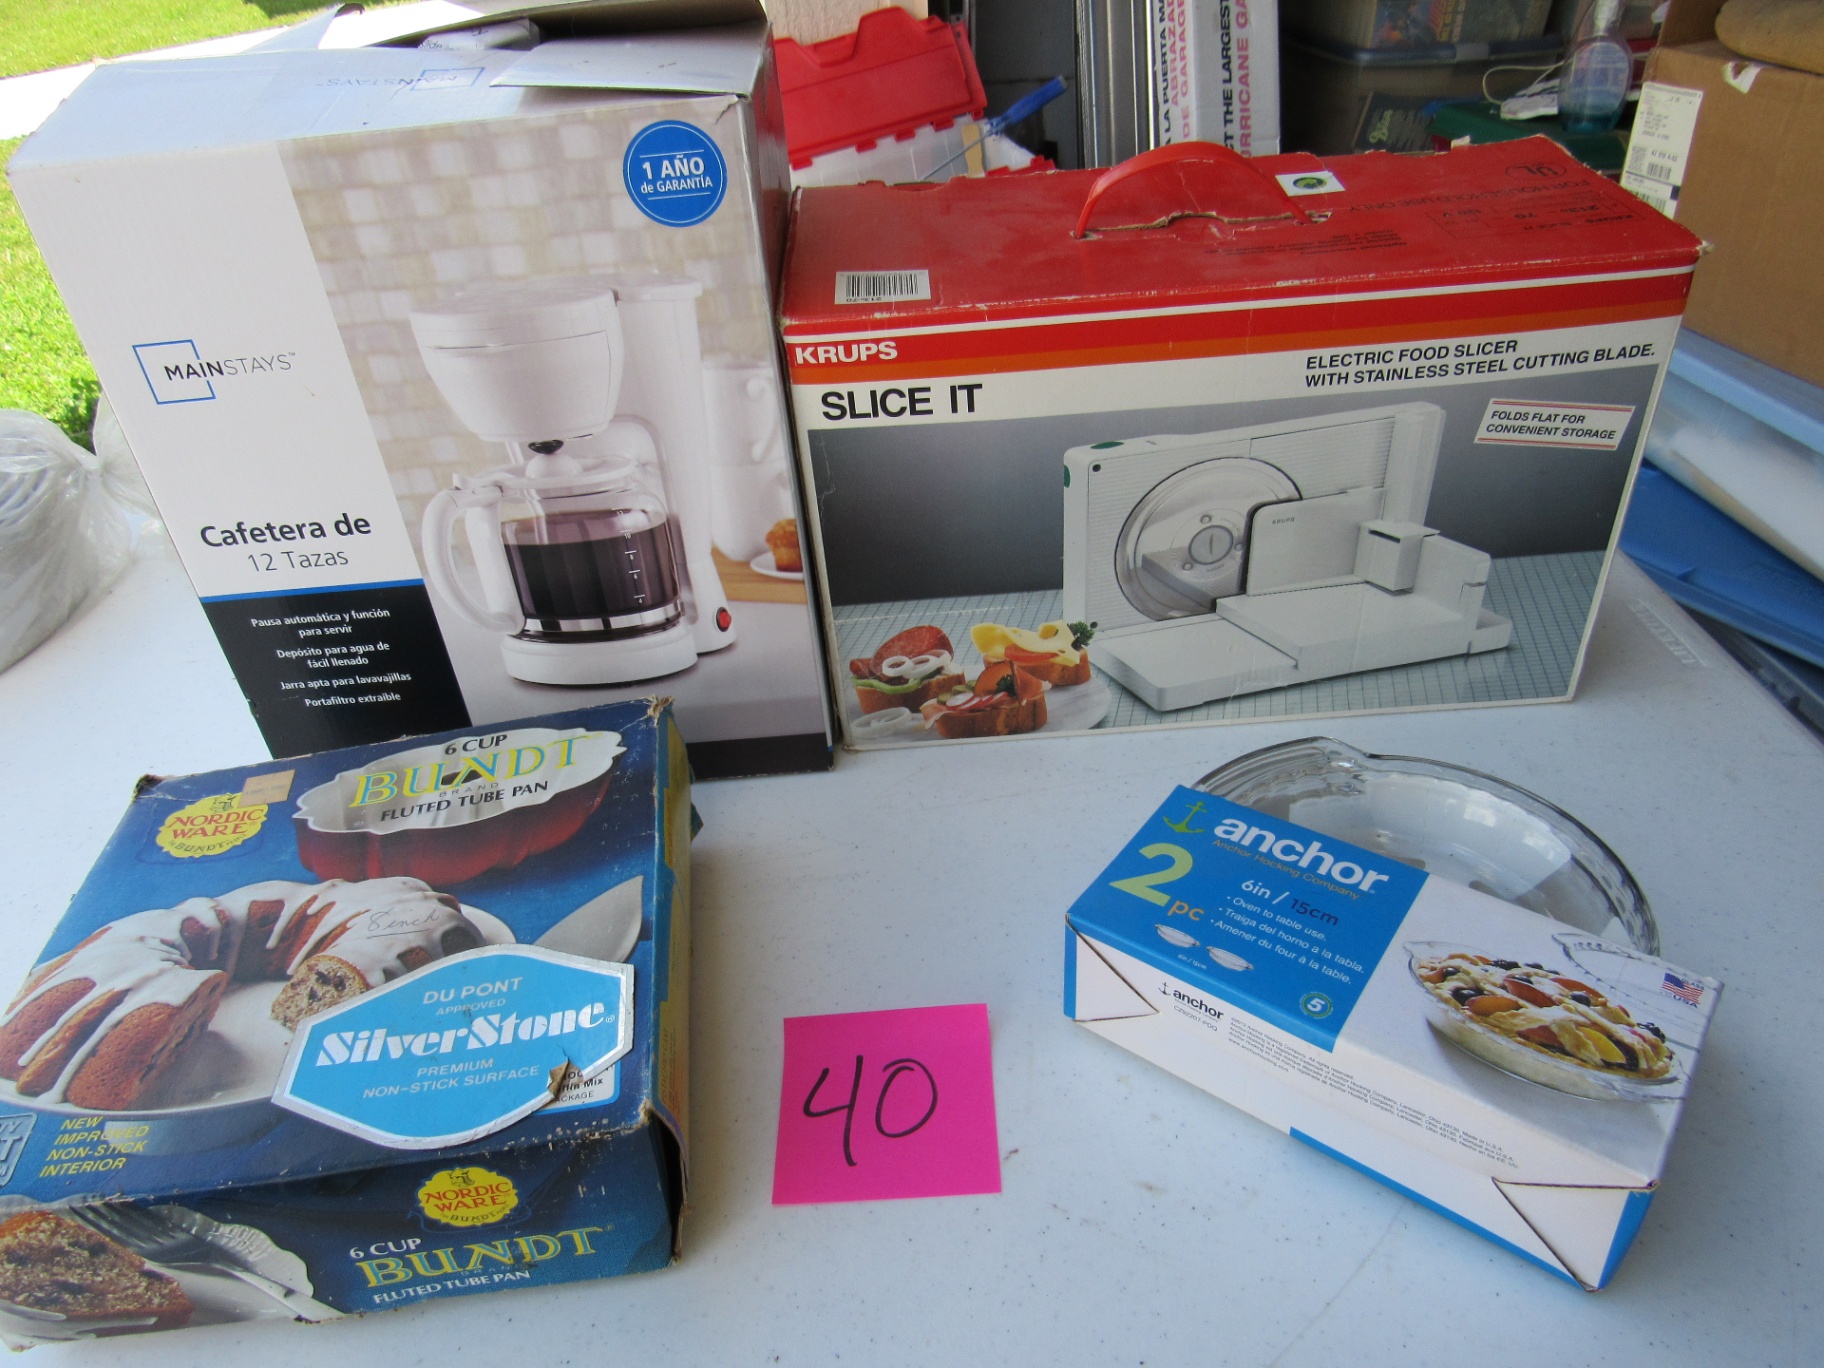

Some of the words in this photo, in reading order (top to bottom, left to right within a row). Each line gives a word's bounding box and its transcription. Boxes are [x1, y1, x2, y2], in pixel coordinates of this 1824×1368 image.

[1159, 28, 1170, 104] PUERTA
[1223, 89, 1233, 128] THE
[1163, 109, 1171, 133] LA
[1181, 105, 1190, 139] DE
[642, 161, 653, 180] 1
[660, 154, 705, 179] AÑO
[640, 181, 654, 194] de
[656, 174, 713, 193] GARANTÍA
[795, 341, 898, 365] KRUPS
[1305, 350, 1395, 370] ELECTRIC
[1398, 345, 1450, 363] FOOD
[1453, 339, 1518, 358] SLICER
[1305, 371, 1349, 388] WITH
[1353, 364, 1449, 385] STAINLESS
[1453, 359, 1508, 377] STEEL
[1512, 350, 1589, 371] CUTTING
[1593, 343, 1655, 363] BLADE.
[820, 386, 934, 421] SLICE
[949, 383, 983, 414] IT
[1490, 410, 1531, 422] FOLDS
[1531, 412, 1560, 423] FLAT
[1562, 414, 1586, 425] FOR
[1486, 423, 1560, 437] CONVENIENT
[1561, 427, 1617, 441] STORAGE
[200, 519, 327, 548] Cafetera
[333, 512, 372, 537] de
[247, 553, 278, 572] 12
[280, 550, 349, 569] Tazas
[250, 617, 282, 628] Pausa
[284, 611, 342, 625] automática
[343, 613, 350, 623] y
[351, 608, 391, 620] función
[298, 628, 322, 639] para
[323, 624, 353, 635] servir
[276, 647, 323, 659] Depósito
[324, 646, 348, 657] para
[349, 643, 375, 655] agua
[377, 641, 390, 651] de
[307, 658, 331, 669] fácil
[331, 655, 369, 667] llenado
[281, 679, 306, 690] Jarra
[307, 678, 331, 690] apta
[332, 676, 355, 688] para
[356, 671, 412, 686] lavavajillas
[305, 695, 356, 707] Portafiltro
[357, 691, 402, 704] extraíble
[444, 741, 457, 755] 6
[460, 733, 508, 753] CUP
[350, 734, 593, 808] BUNDT
[439, 781, 499, 798] BRAND
[380, 798, 452, 822] FLUTED
[457, 789, 505, 808] TUBE
[510, 781, 549, 797] PAN
[168, 808, 265, 832] NORDIC
[171, 821, 249, 840] WARE
[1213, 817, 1390, 895] anchor
[1109, 842, 1194, 907] 2
[1212, 838, 1252, 859] Anchor
[1253, 854, 1300, 879] Hocking
[1302, 871, 1362, 900] Company
[1167, 900, 1205, 925] pc
[1240, 878, 1272, 901] 6in
[1272, 891, 1291, 905] /
[1290, 897, 1340, 927] 15cm
[1232, 896, 1260, 913] Oven
[1262, 907, 1275, 919] to
[1276, 911, 1304, 931] table
[1305, 924, 1327, 942] use.
[1214, 919, 1257, 944] Amener
[1258, 936, 1273, 950] du
[1274, 942, 1296, 961] four
[1297, 953, 1307, 966] à
[1308, 956, 1320, 970] la
[1320, 963, 1352, 984] table.
[1224, 907, 1257, 932] Traiga
[1258, 922, 1276, 936] del
[1278, 930, 1309, 949] horno
[1310, 945, 1320, 955] a
[1321, 947, 1333, 960] la
[1334, 954, 1365, 974] tabla.
[422, 987, 457, 1005] DU
[459, 976, 523, 998] PONT
[1672, 994, 1699, 1009] USA
[435, 997, 507, 1017] APPROVED
[1172, 987, 1225, 1020] anchor
[1306, 997, 1326, 1012] 5
[416, 1057, 494, 1078] PREMIUM
[362, 1077, 460, 1099] NON-STICK
[463, 1065, 540, 1086] SURFACE
[583, 1077, 604, 1090] Mix
[803, 1054, 938, 1167] 40
[60, 1116, 104, 1130] NEW
[53, 1125, 150, 1146] IMPROVED
[46, 1140, 148, 1162] NON-STICK
[39, 1157, 127, 1178] INTERIOR
[424, 1181, 511, 1204] NORDIC
[433, 1194, 507, 1213] WARE
[450, 1211, 497, 1222] BUNDT
[349, 1246, 365, 1260] 6
[369, 1237, 422, 1256] CUP
[373, 1282, 442, 1304] FLUTED
[446, 1274, 490, 1291] TUBE
[493, 1269, 531, 1284] PAN
